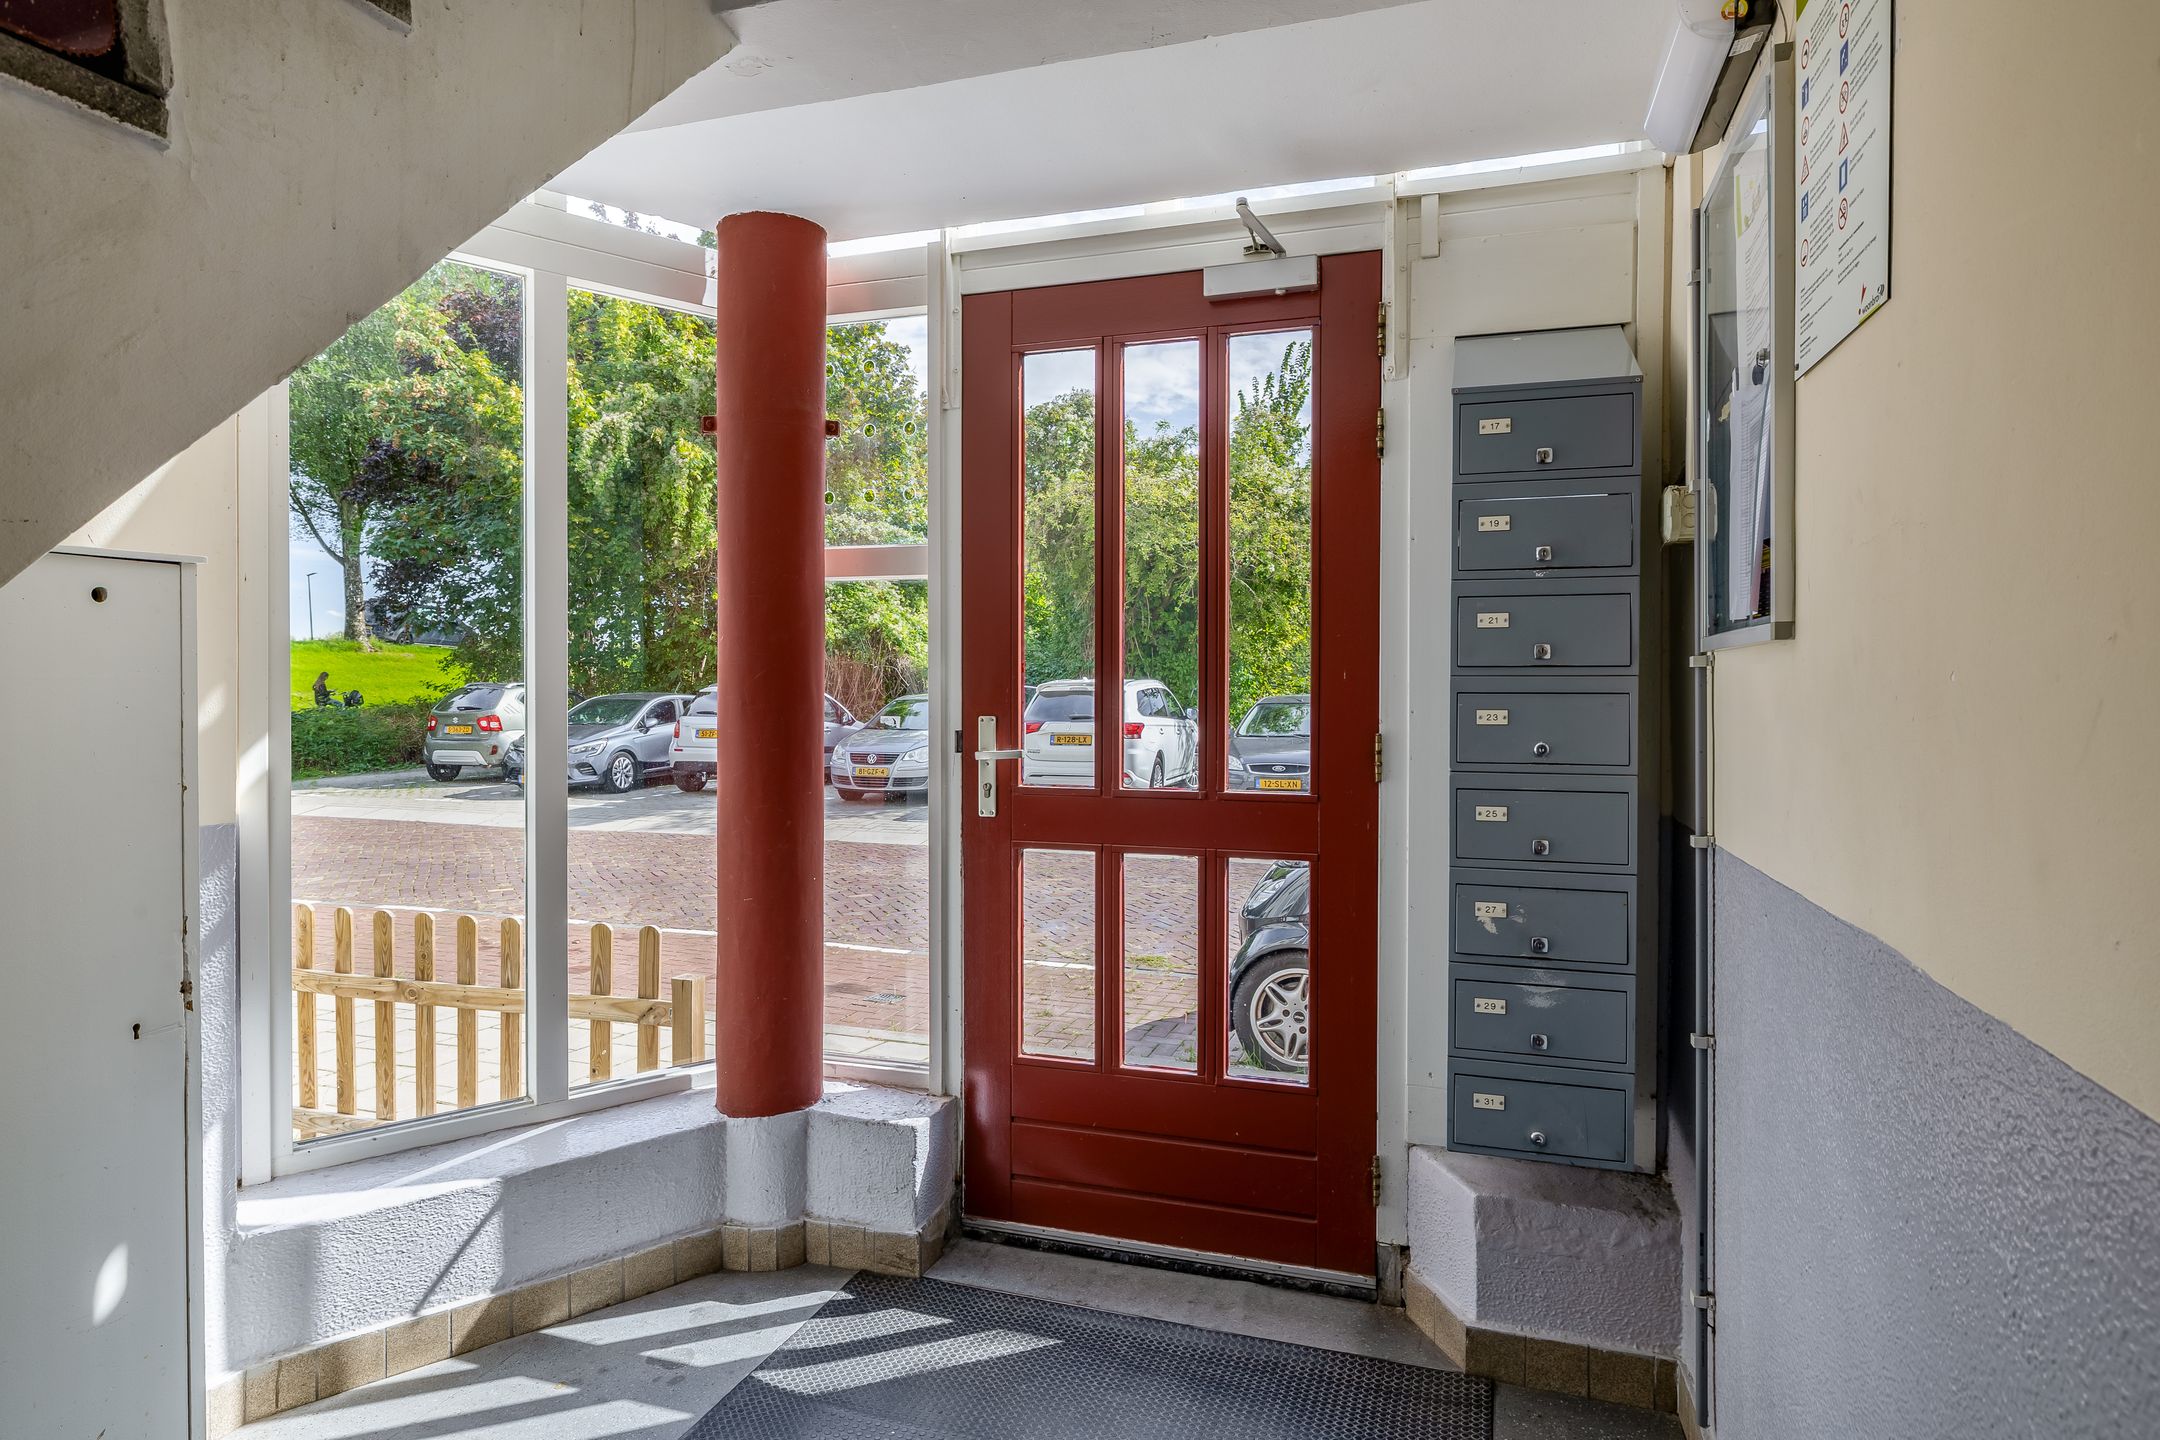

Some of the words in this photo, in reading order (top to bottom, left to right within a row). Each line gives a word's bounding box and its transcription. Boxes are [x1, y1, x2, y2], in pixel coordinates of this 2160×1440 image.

[1490, 422, 1500, 430] 17
[1489, 519, 1500, 528] 19
[1488, 616, 1498, 624] 21
[1486, 713, 1498, 721] 23
[1263, 780, 1298, 789] 12-SL-XN
[1485, 810, 1498, 818] 25
[1485, 905, 1497, 914] 27
[1484, 1002, 1496, 1011] 29
[1484, 1097, 1494, 1106] 31
